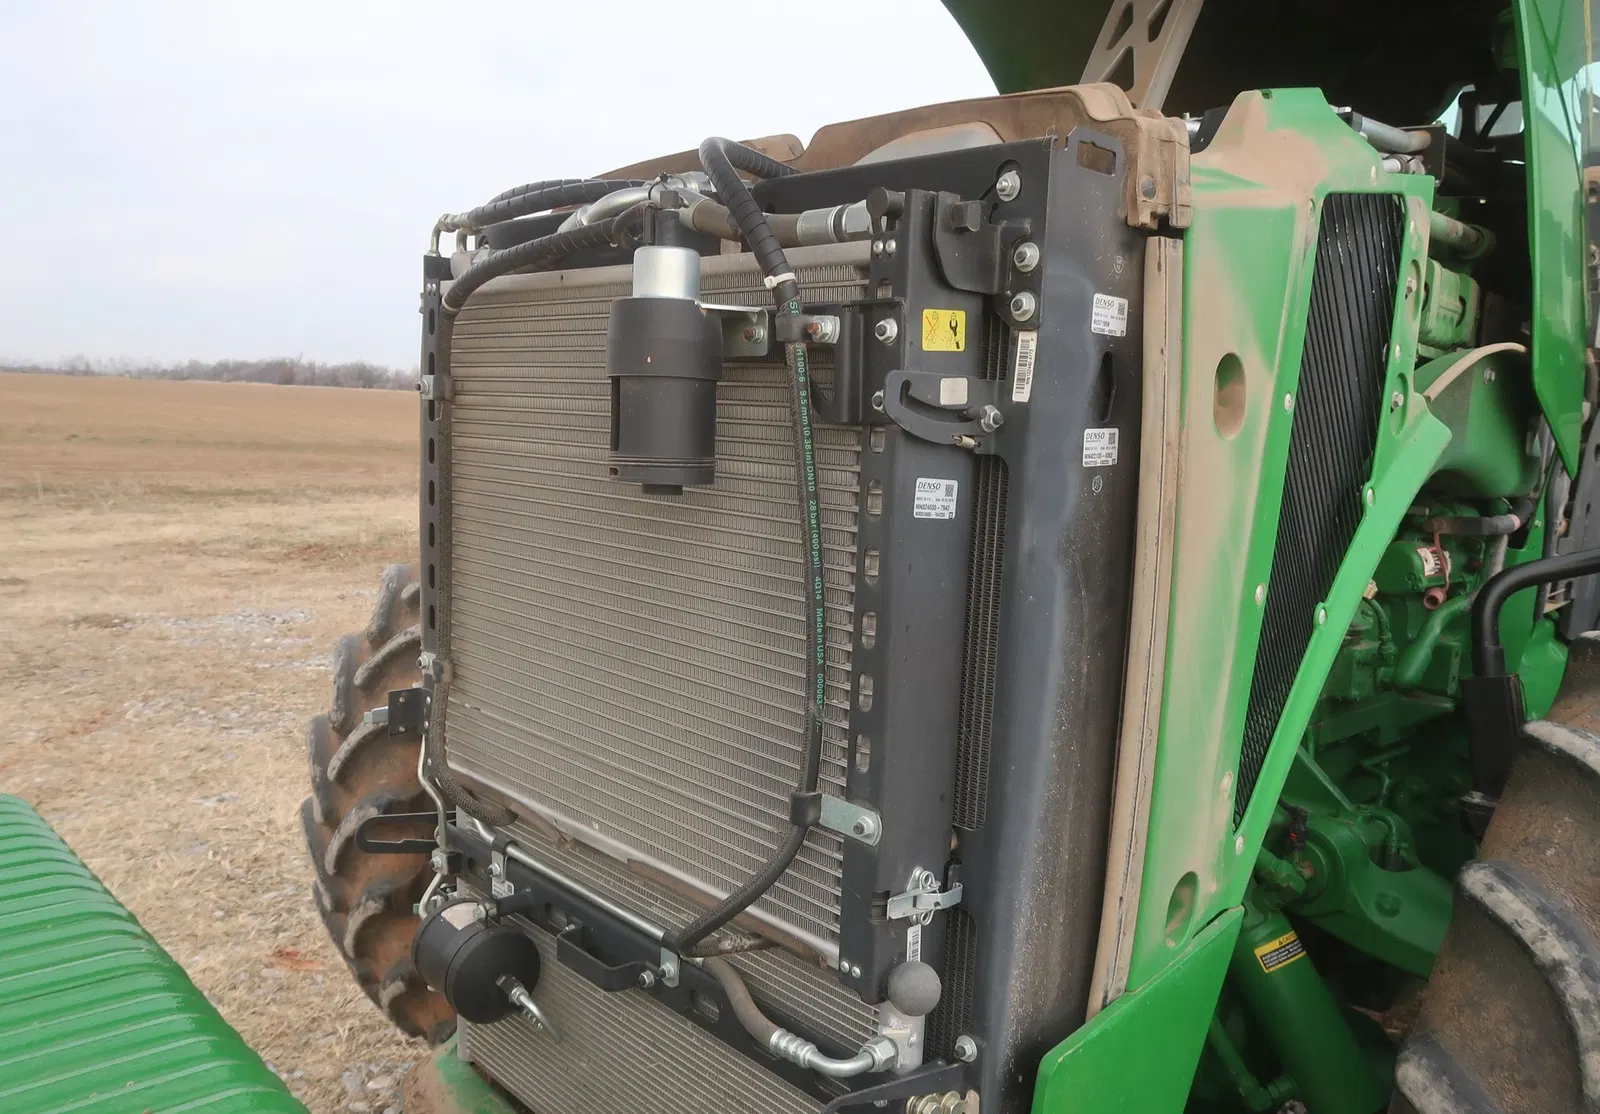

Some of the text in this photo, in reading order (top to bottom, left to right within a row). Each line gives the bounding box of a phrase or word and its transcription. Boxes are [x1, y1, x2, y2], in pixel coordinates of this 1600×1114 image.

[1095, 297, 1115, 308] DENSO
[800, 390, 808, 405] 9.5
[801, 406, 808, 425] mm
[1086, 431, 1106, 440] DENSO
[807, 466, 815, 492] DN10
[917, 481, 941, 491] DENSO
[809, 500, 817, 511] 28
[810, 512, 818, 528] bar
[811, 530, 820, 550] (400
[816, 608, 824, 633] Made
[816, 634, 824, 643] in
